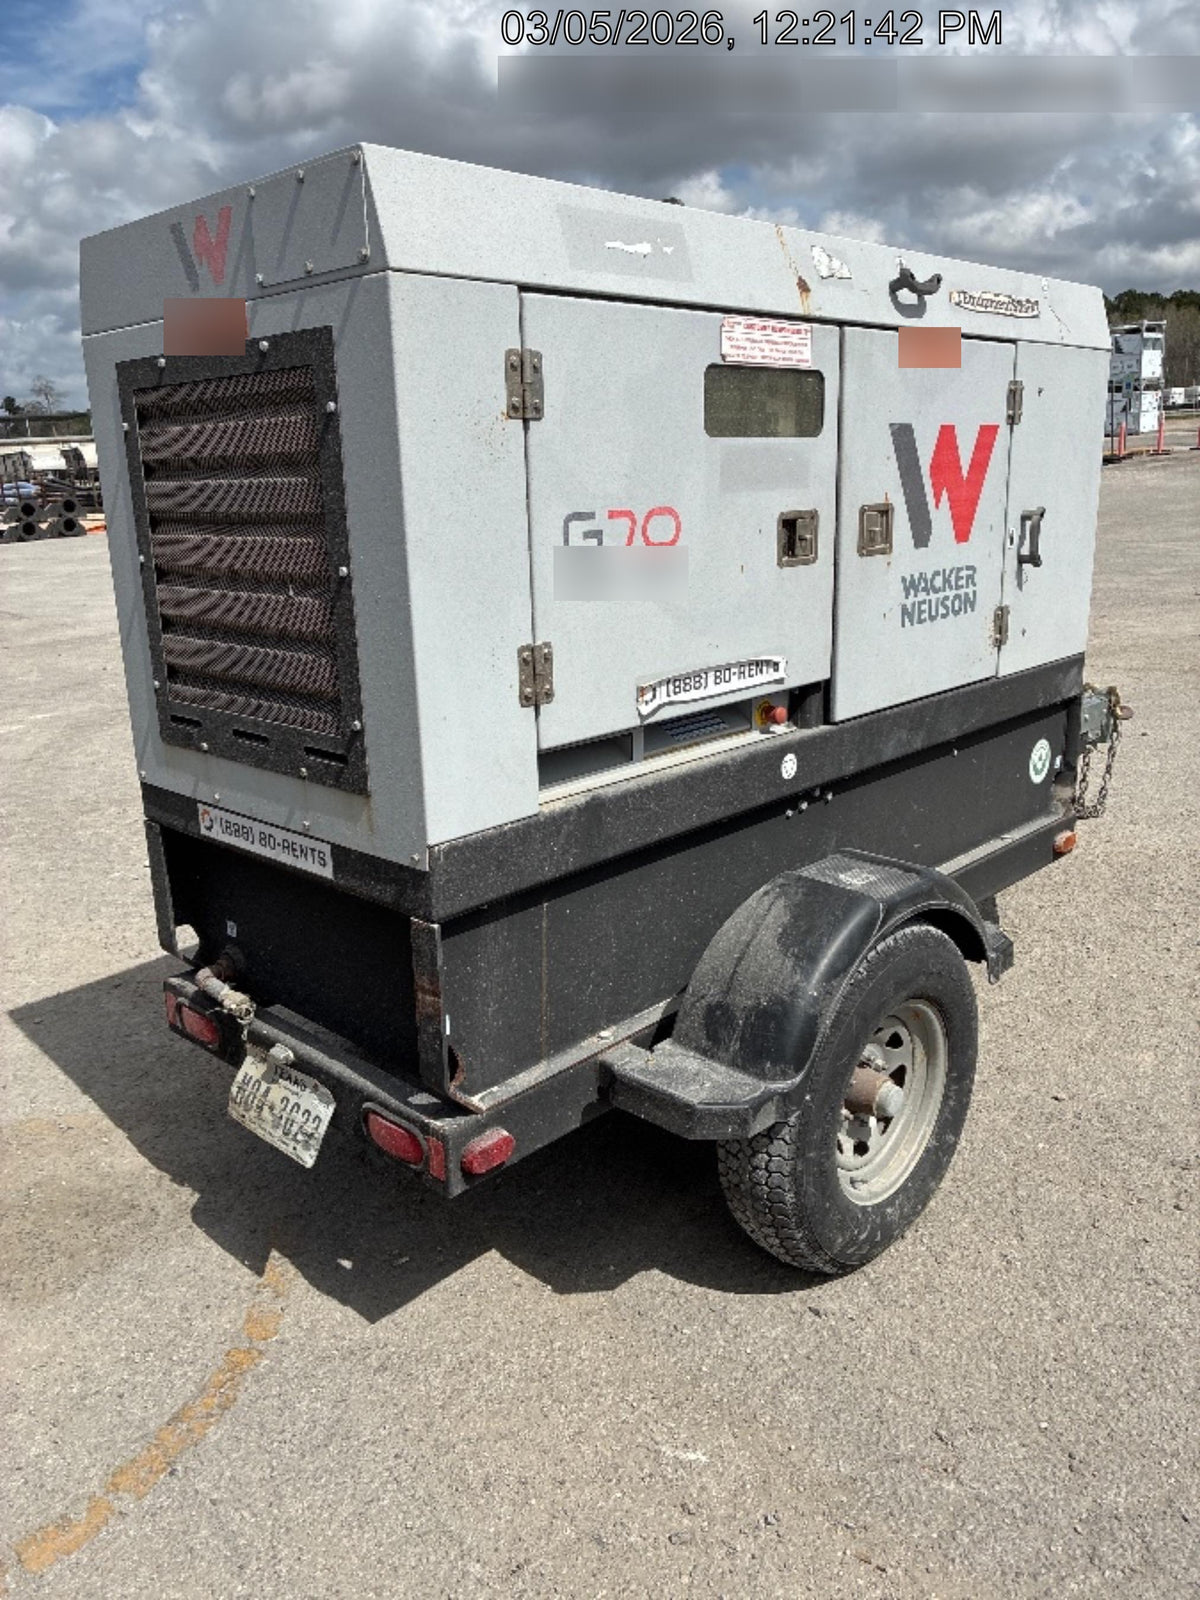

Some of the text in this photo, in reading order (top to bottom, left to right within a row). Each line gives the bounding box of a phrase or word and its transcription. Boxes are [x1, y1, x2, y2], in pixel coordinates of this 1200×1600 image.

[901, 565, 977, 599] WACKER
[900, 590, 977, 628] NEUSON
[666, 671, 708, 697] (888)
[221, 818, 327, 867] (888) 80-RENTS
